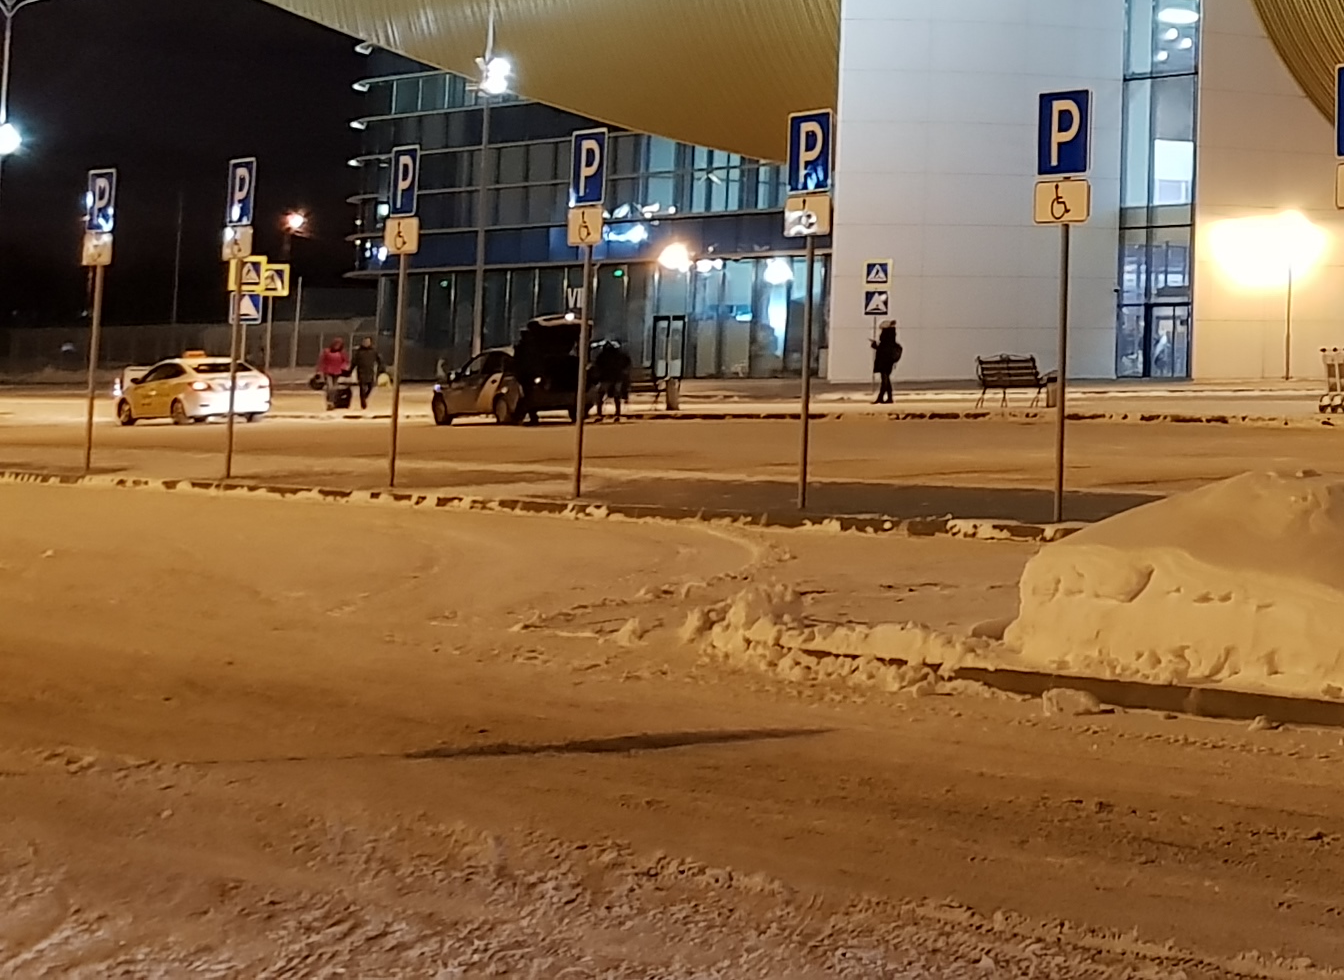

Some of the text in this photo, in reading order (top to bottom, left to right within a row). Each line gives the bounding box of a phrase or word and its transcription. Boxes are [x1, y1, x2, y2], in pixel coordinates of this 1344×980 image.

[799, 121, 823, 189] P
[1050, 99, 1081, 167] P
[234, 167, 250, 219] P
[396, 155, 414, 209] P
[578, 139, 600, 197] P
[567, 287, 586, 308] VI
